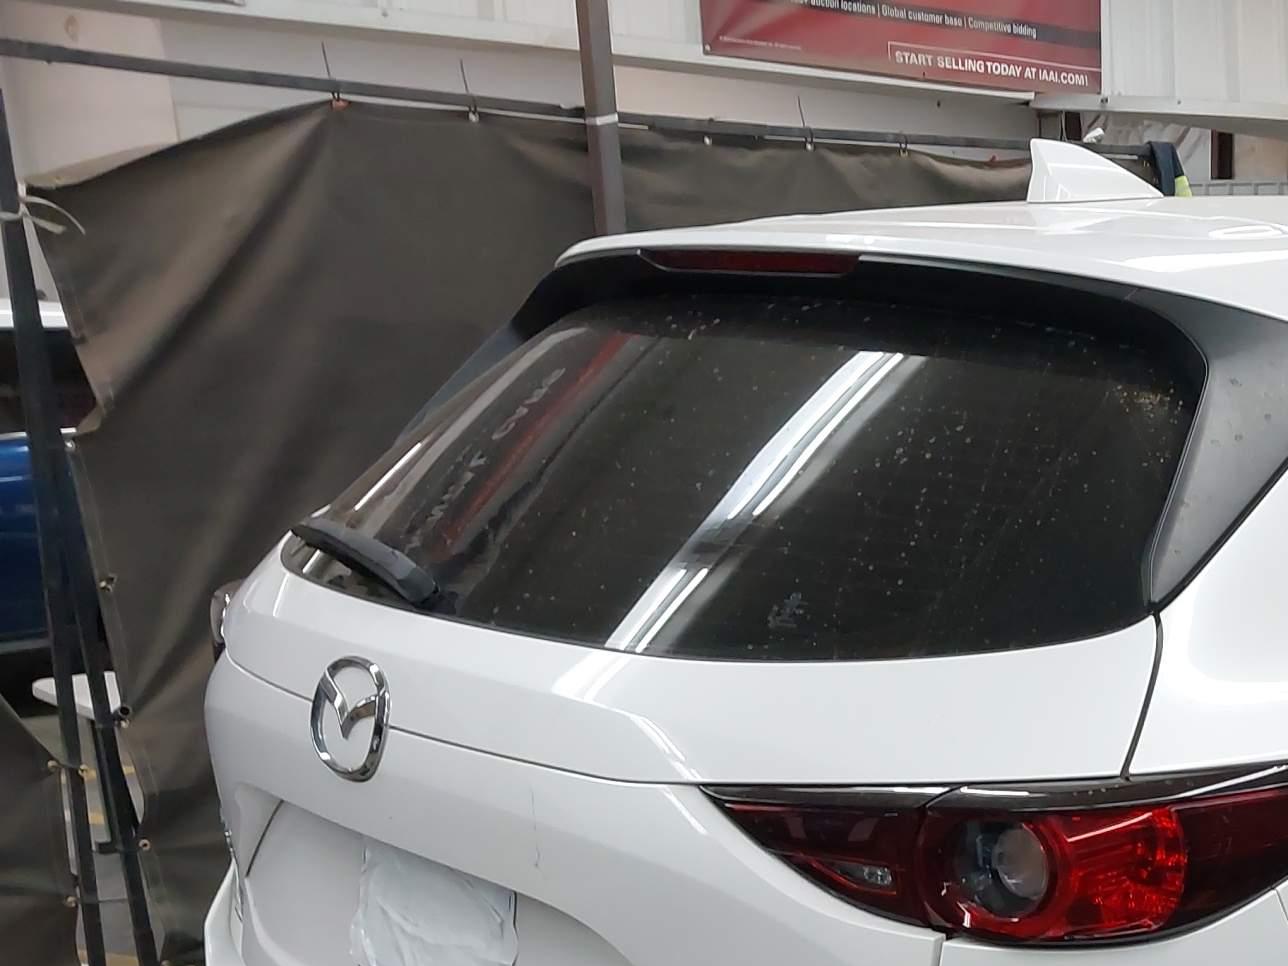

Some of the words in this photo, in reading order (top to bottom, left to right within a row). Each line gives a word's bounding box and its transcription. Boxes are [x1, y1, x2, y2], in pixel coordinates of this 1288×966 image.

[840, 0, 875, 15] locations
[881, 4, 906, 20] Global
[908, 12, 942, 25] customer
[944, 16, 962, 27] base
[968, 17, 1012, 34] Competitive
[1012, 23, 1037, 39] bidding
[895, 50, 933, 66] START
[937, 56, 985, 73] SELLING
[986, 61, 1022, 77] TODAY
[1024, 68, 1037, 80] AT
